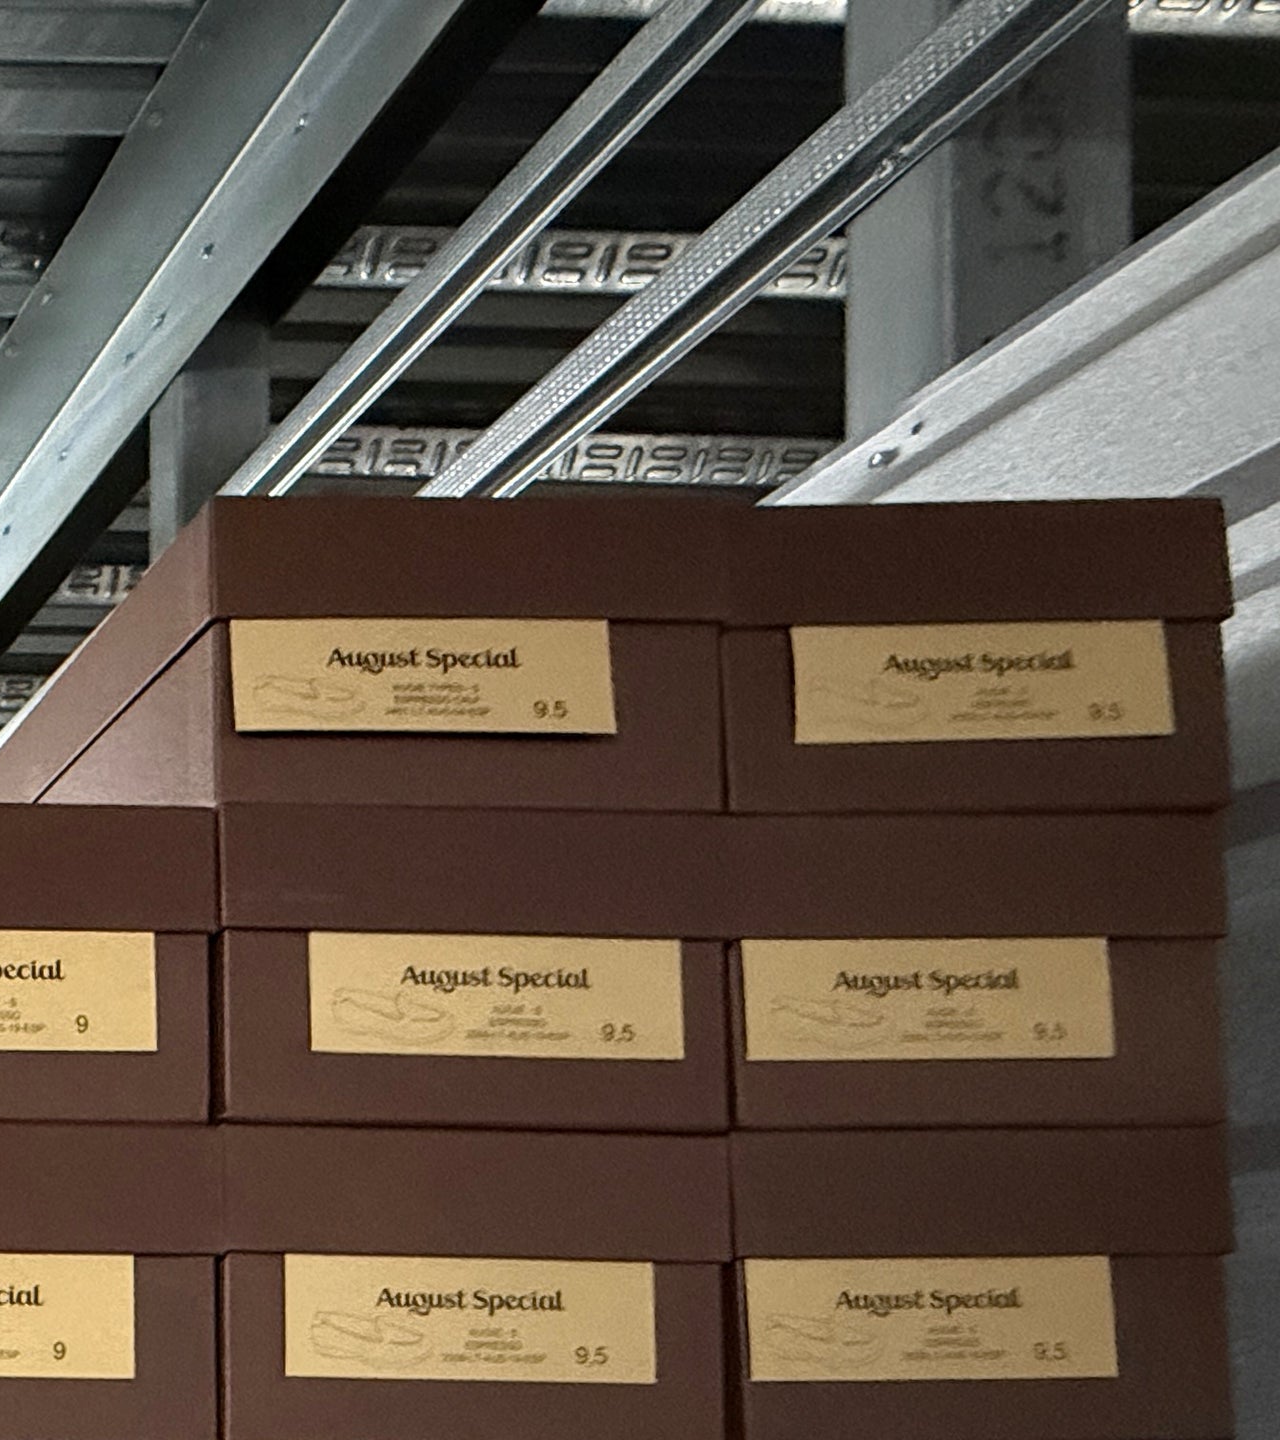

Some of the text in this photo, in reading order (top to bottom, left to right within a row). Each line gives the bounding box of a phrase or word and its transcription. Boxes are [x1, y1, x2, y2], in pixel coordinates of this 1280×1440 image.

[327, 648, 522, 675] August Special
[884, 650, 1076, 681] August Special
[401, 966, 591, 994] August Special
[832, 968, 1019, 998] August Special
[75, 1015, 88, 1033] 9
[376, 1288, 565, 1317] August Special
[836, 1288, 1023, 1317] August Special
[53, 1341, 66, 1360] 9
